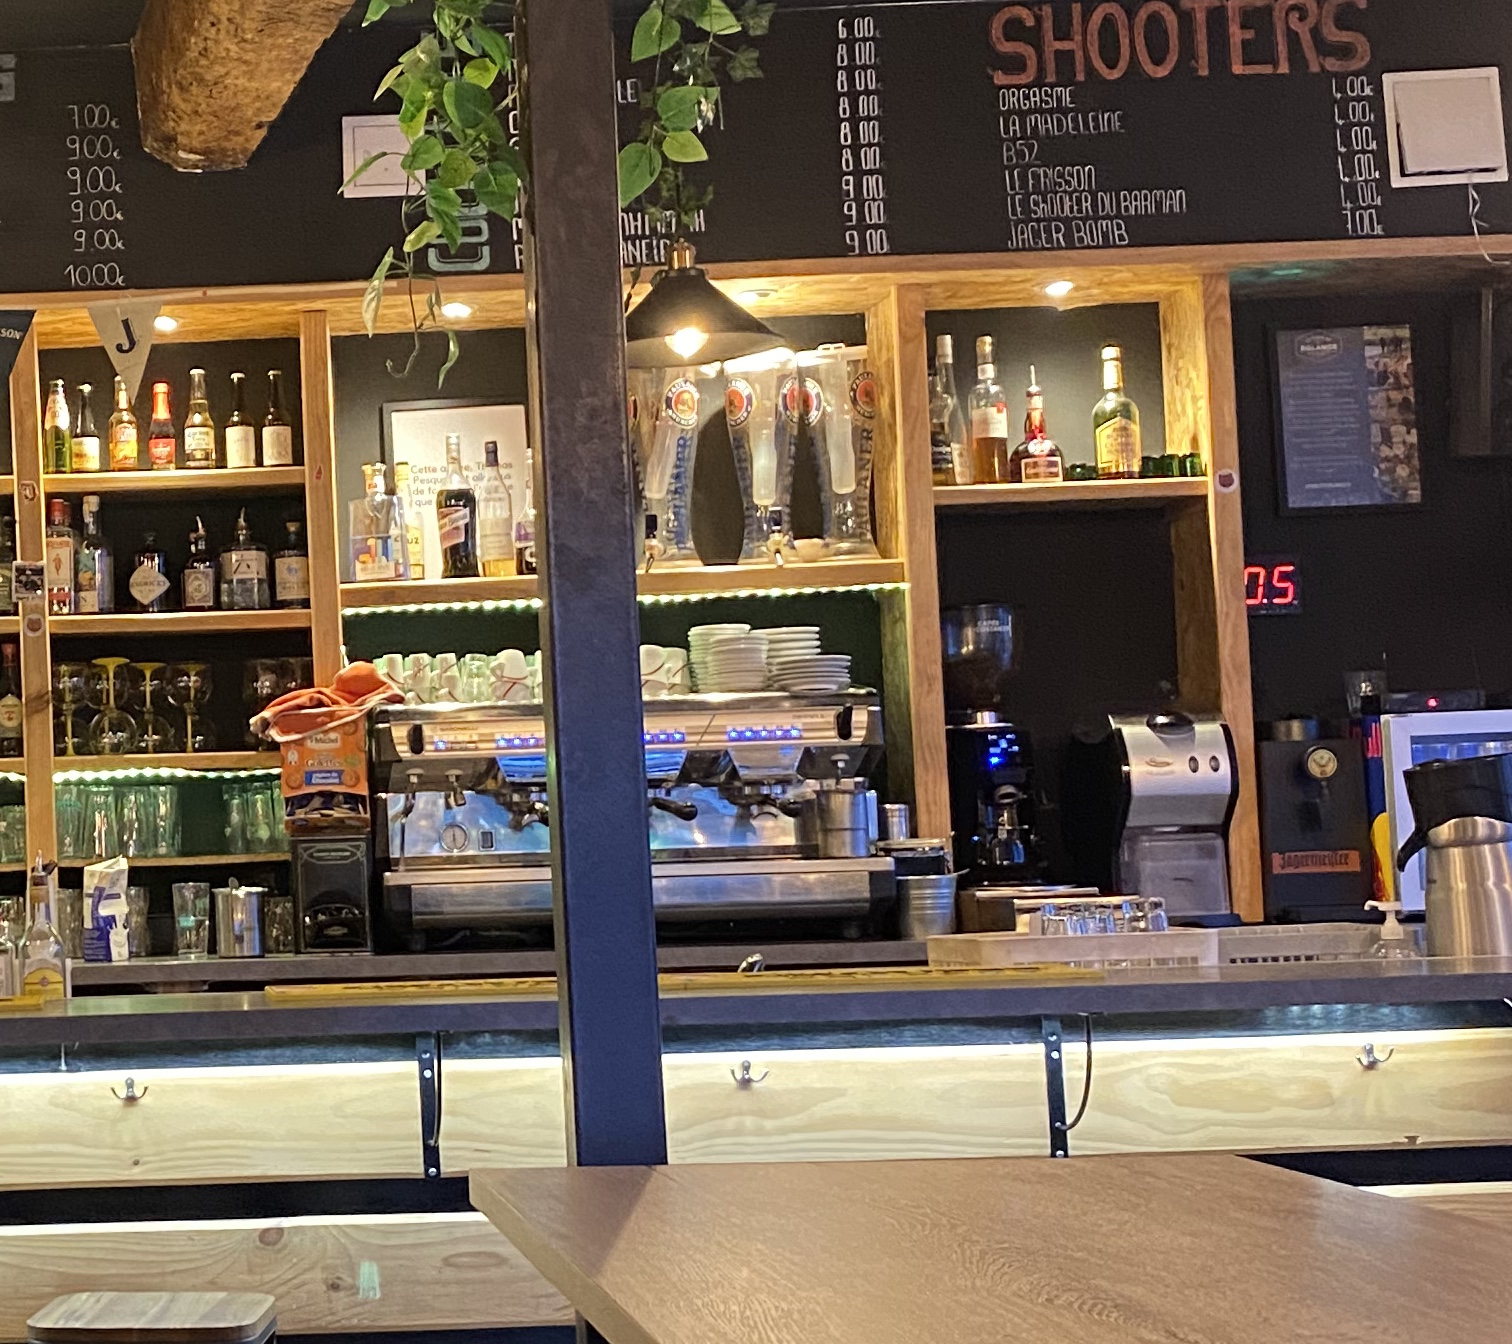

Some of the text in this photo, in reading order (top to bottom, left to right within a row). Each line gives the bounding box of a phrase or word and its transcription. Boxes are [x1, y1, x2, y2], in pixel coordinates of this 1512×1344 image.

[998, 86, 1076, 111] ORGASME
[999, 114, 1021, 138] LA
[1027, 110, 1125, 135] MADELEINE
[1003, 140, 1041, 165] B52
[66, 166, 123, 195] 9.00€
[1005, 167, 1022, 194] LE
[1028, 164, 1096, 192] FRISSON
[1007, 195, 1023, 219] LE
[1098, 191, 1117, 215] DU
[1120, 189, 1187, 215] BARMAN
[1007, 220, 1066, 249] JAGER
[1072, 219, 1130, 246] BOMB
[115, 316, 139, 355] J
